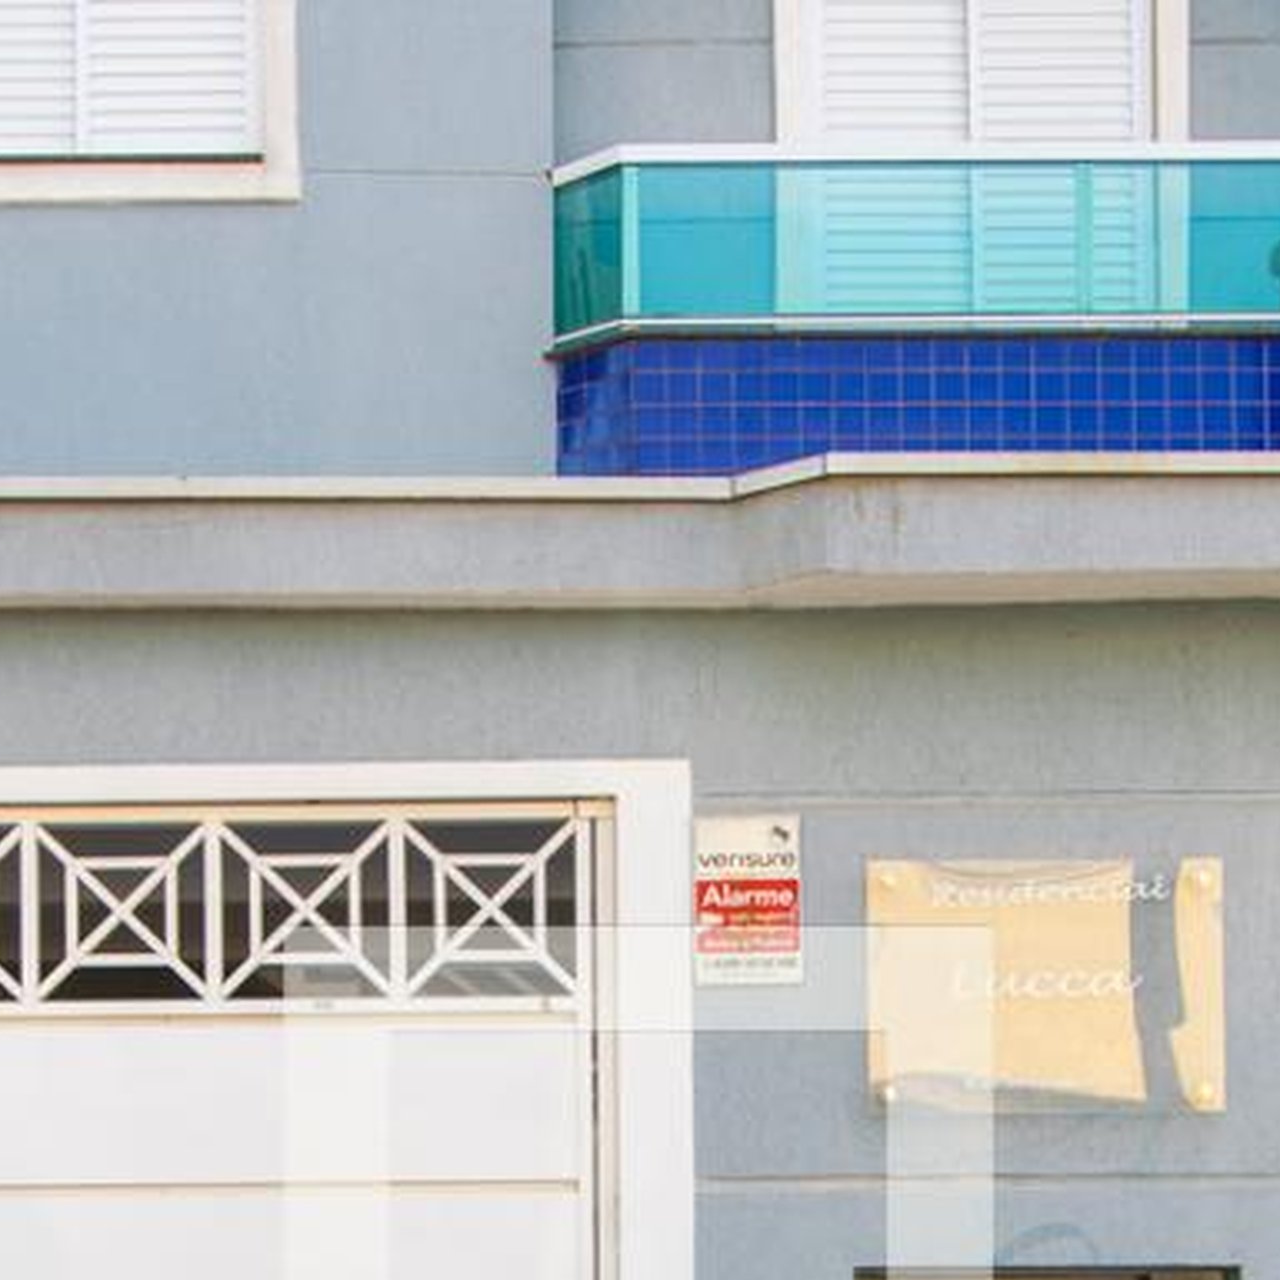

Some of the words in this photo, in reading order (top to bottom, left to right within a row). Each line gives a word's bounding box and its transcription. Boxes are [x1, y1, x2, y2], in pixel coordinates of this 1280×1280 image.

[698, 852, 795, 868] verisure
[702, 883, 794, 908] Alarme
[952, 956, 1143, 998] Lucca
